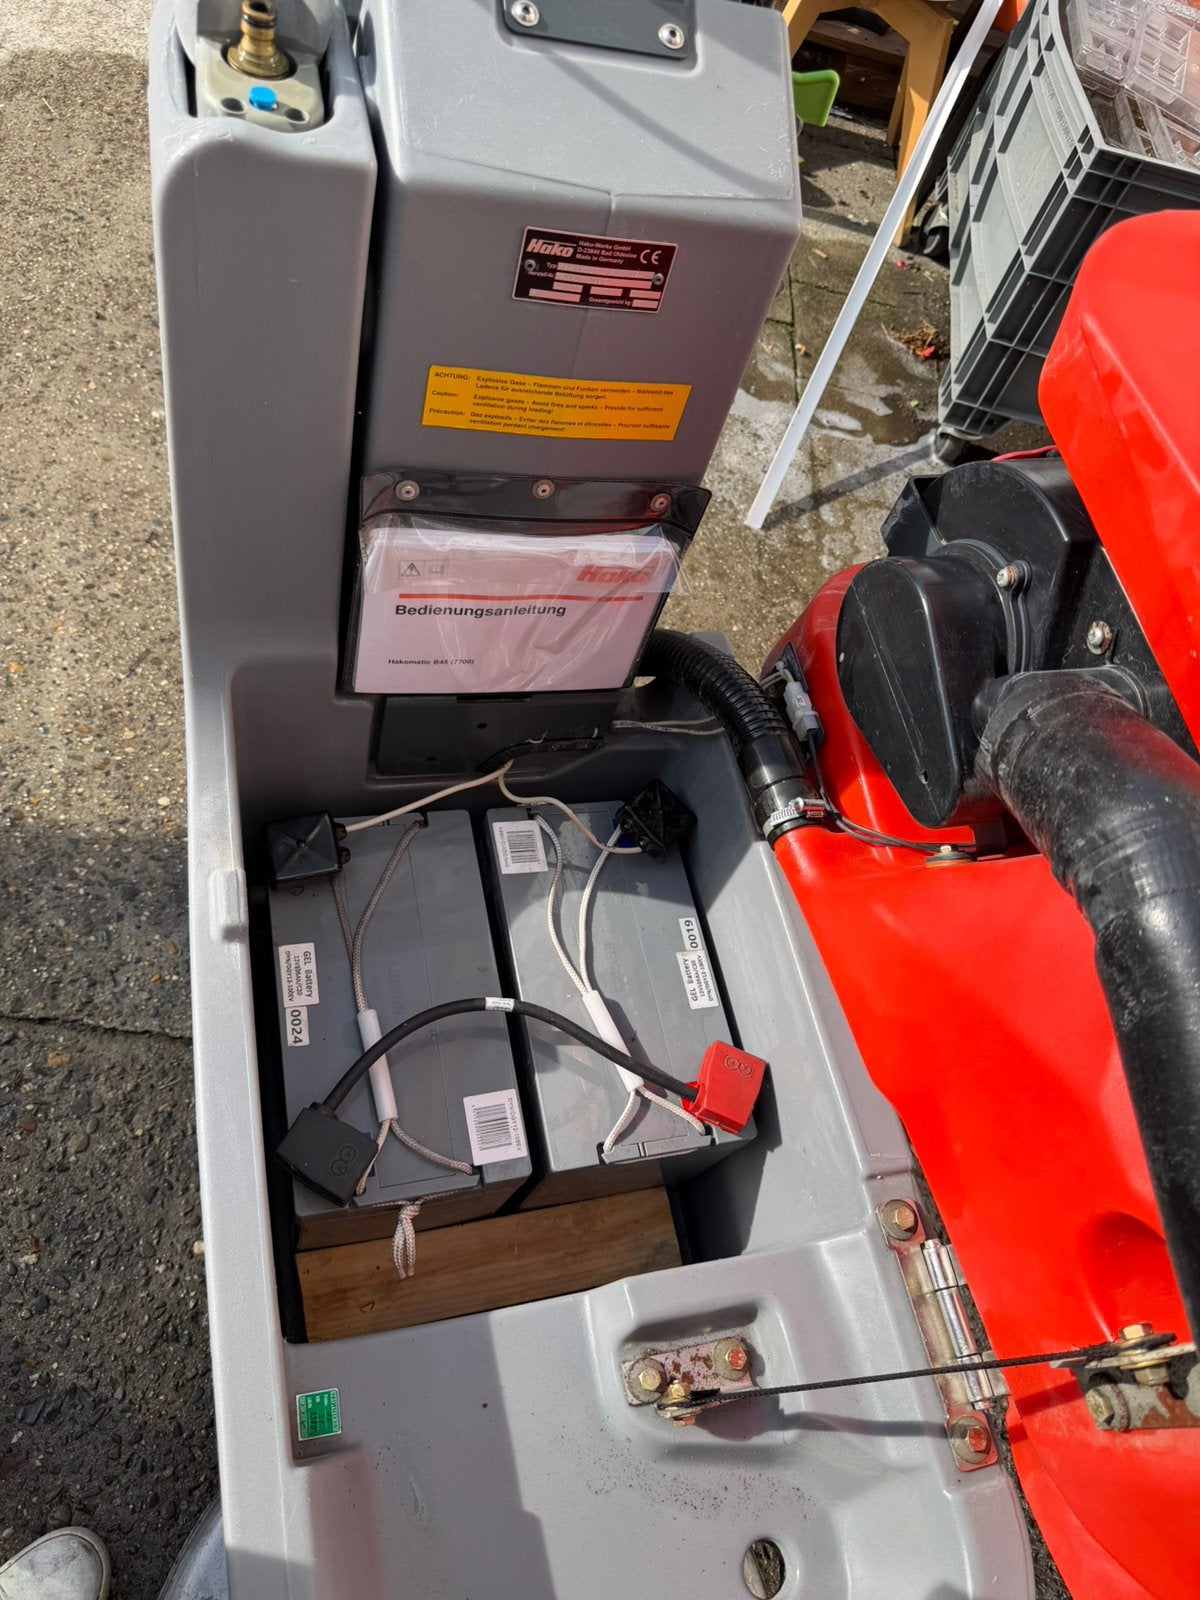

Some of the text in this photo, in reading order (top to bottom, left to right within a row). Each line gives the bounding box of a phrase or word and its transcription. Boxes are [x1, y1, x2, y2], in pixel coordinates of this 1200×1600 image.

[526, 238, 574, 257] Hako
[578, 240, 612, 250] Hako-Werke
[599, 256, 624, 264] Germany
[613, 250, 637, 258] Oldesloe
[434, 372, 470, 380] ACHTUNG:
[477, 376, 508, 384] Explosive
[511, 387, 553, 396] ausreichende
[554, 391, 584, 399] Belüftung
[576, 565, 652, 583] Hako
[395, 605, 566, 619] Bedienungsanleitung
[684, 920, 699, 948] 0019
[303, 950, 313, 998] GEL Battery
[683, 958, 698, 1001] GEL Battery
[290, 1009, 303, 1044] 0024
